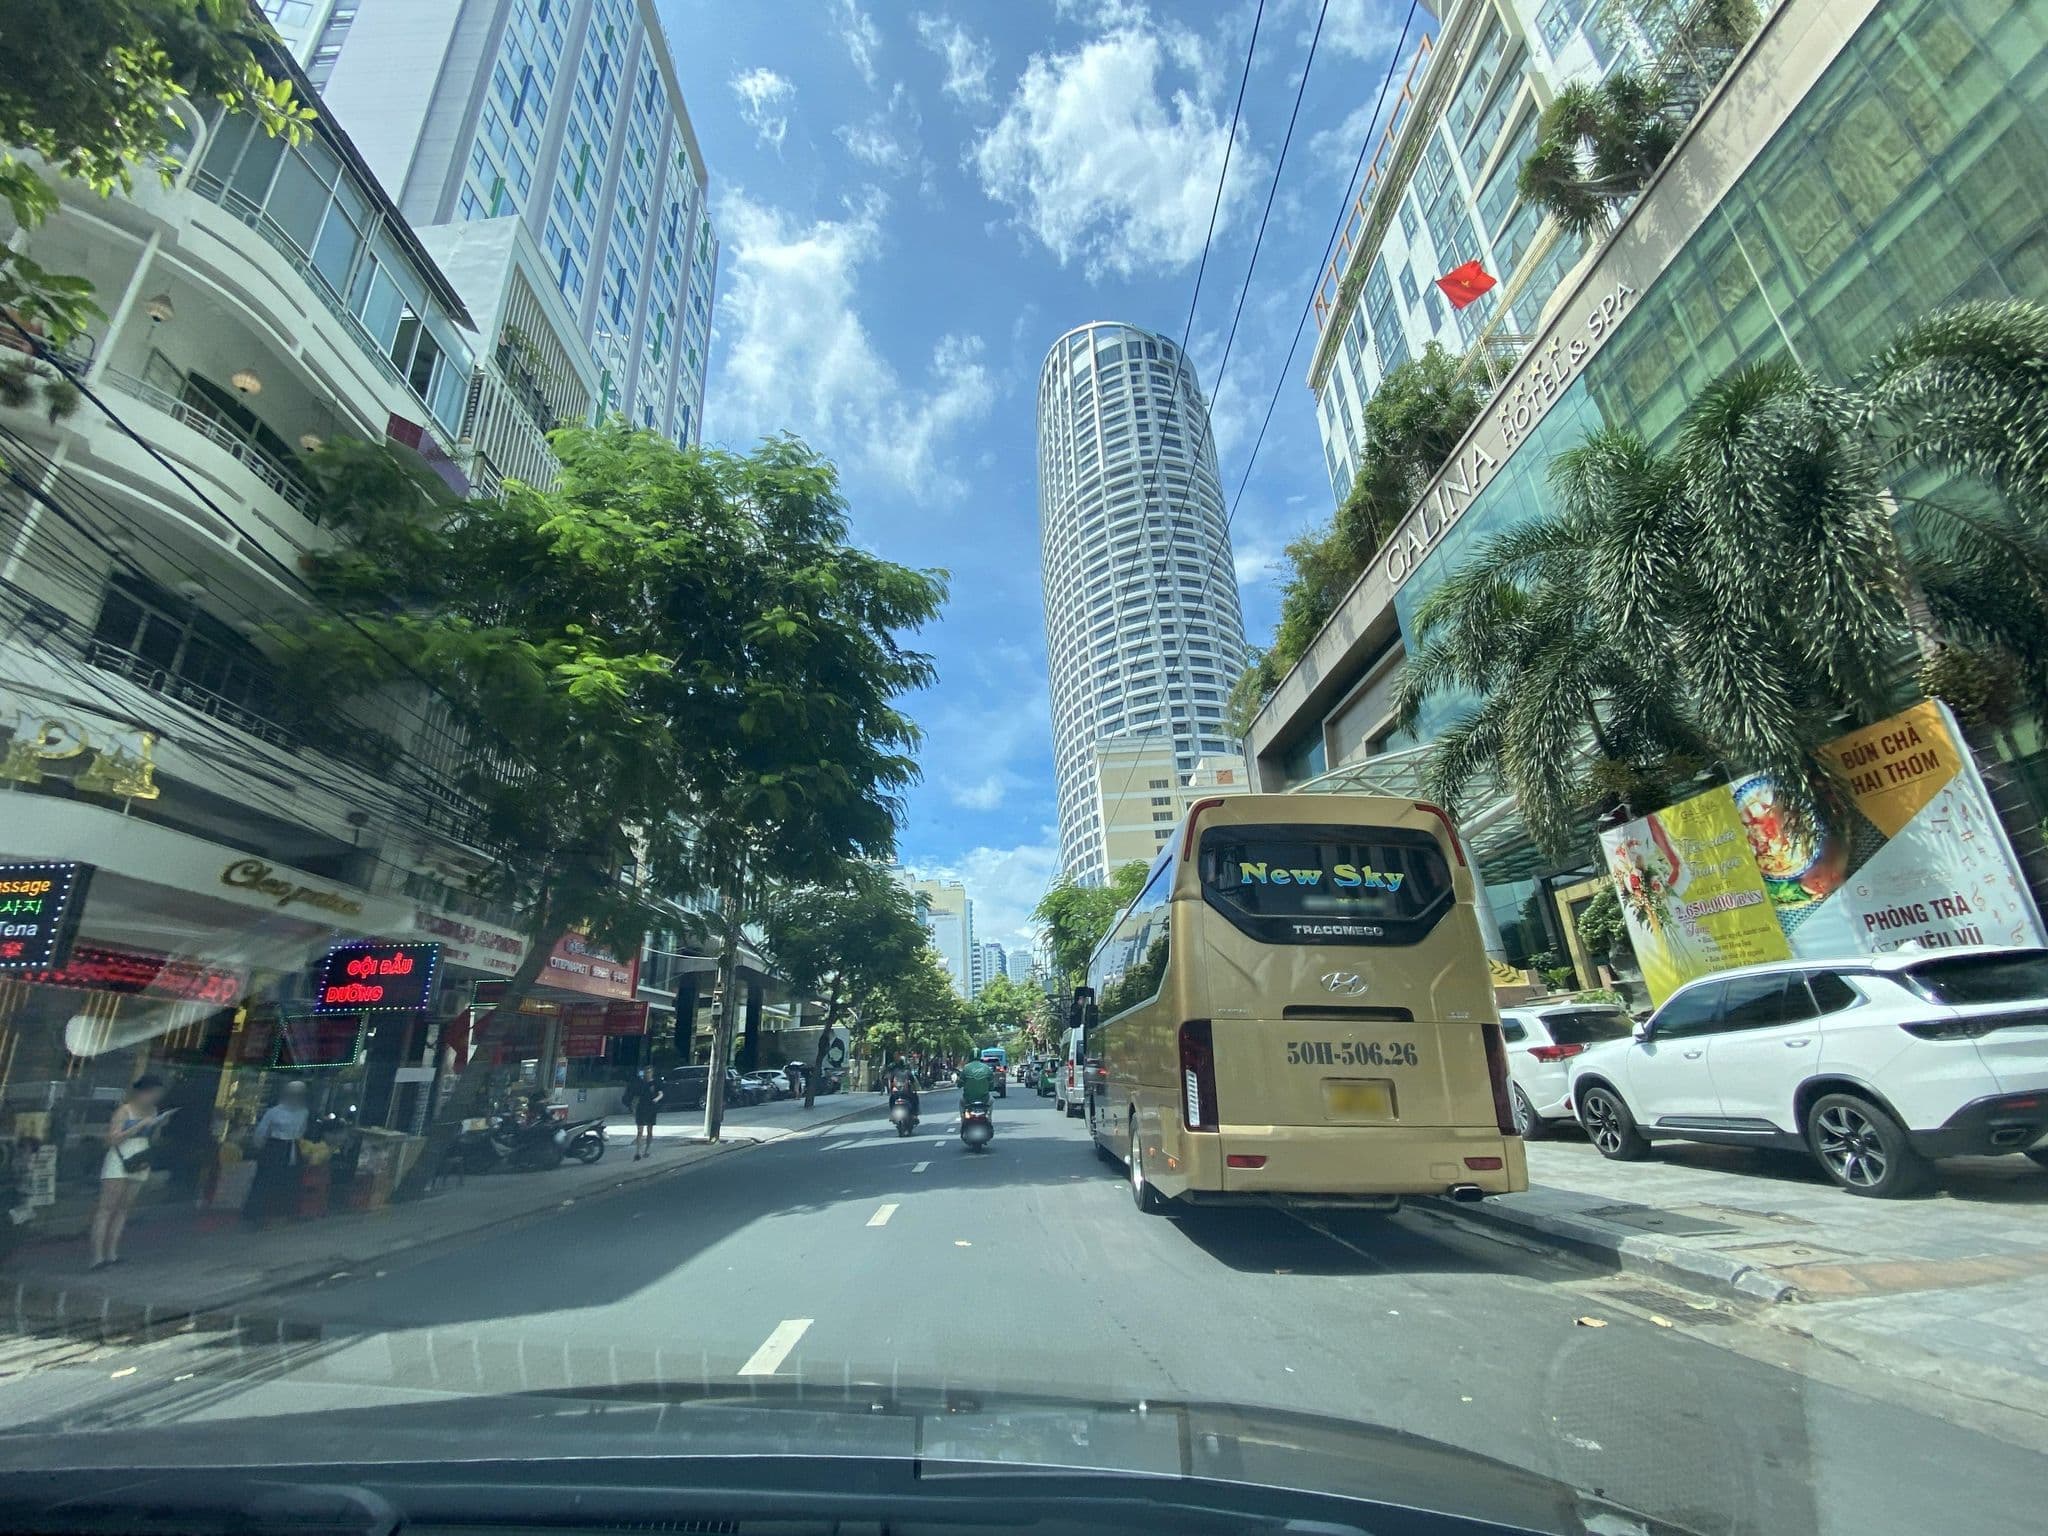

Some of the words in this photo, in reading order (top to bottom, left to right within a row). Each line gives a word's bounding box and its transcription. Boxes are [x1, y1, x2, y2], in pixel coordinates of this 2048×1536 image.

[1386, 441, 1498, 583] GALINA
[1500, 361, 1571, 448] HOTEL
[1568, 340, 1589, 364] &
[1587, 281, 1635, 338] SPA
[1841, 742, 1880, 770] BÚN
[1881, 721, 1922, 755] CHẢ
[1851, 770, 1884, 795] HAI
[0, 881, 51, 896] ssage
[1239, 862, 1322, 886] New
[1333, 864, 1405, 891] Sky
[0, 899, 42, 915] 사지
[1863, 904, 1930, 932] PHÒNG
[1929, 891, 1972, 919] TRÀ
[1293, 925, 1384, 936] TRACOMECO
[1287, 1042, 1418, 1066] 50H-506.26
